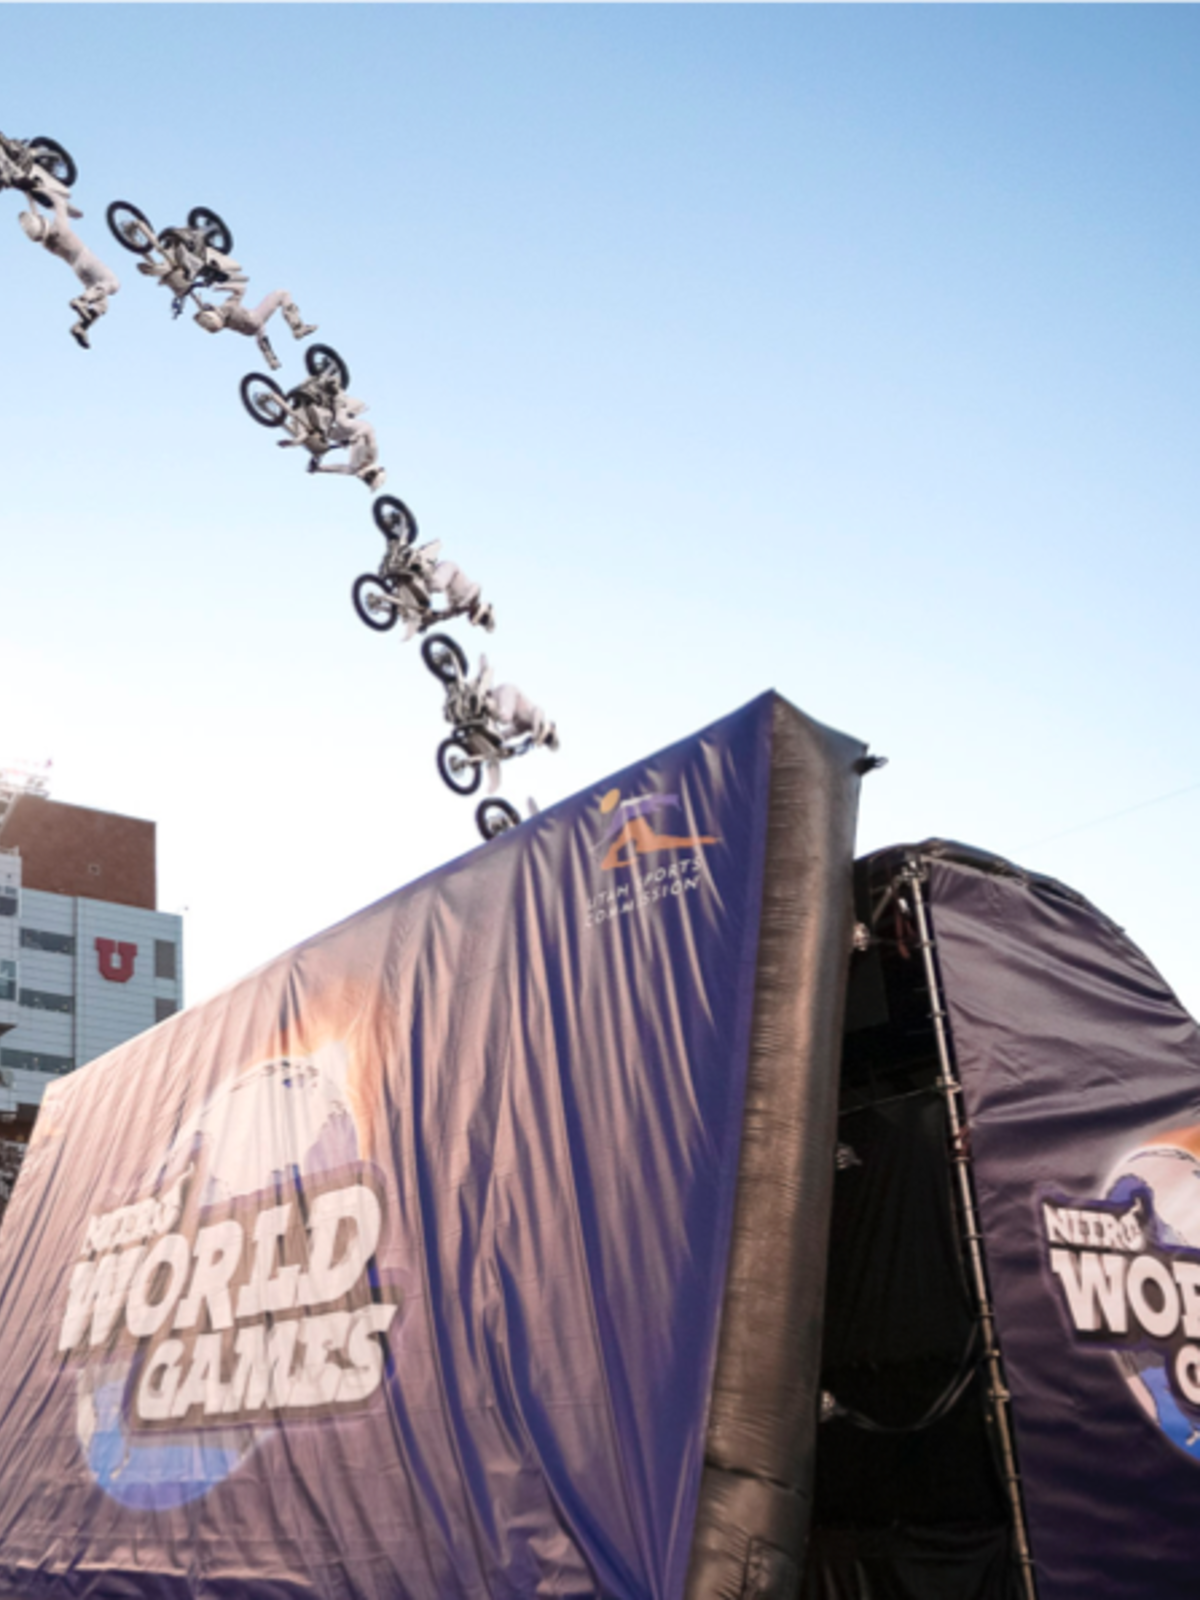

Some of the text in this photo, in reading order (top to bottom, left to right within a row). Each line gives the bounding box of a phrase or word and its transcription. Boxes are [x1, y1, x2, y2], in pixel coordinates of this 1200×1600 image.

[94, 937, 137, 983] U
[1043, 1198, 1146, 1251] NITRO
[58, 1184, 381, 1351] WORLD
[136, 1303, 398, 1421] GAMES
